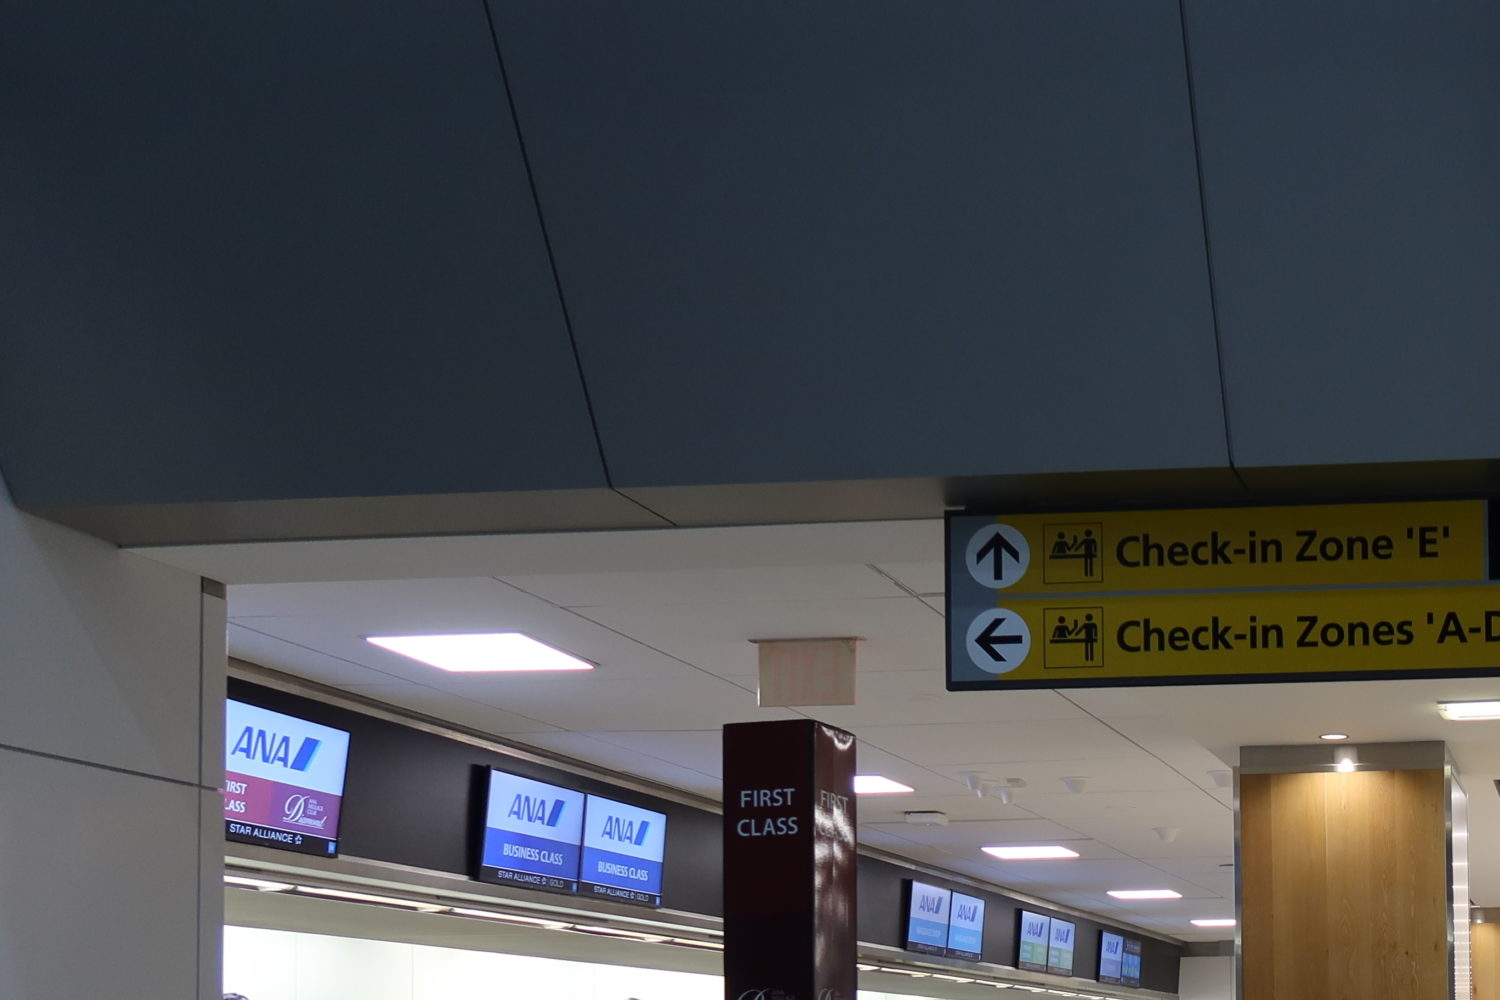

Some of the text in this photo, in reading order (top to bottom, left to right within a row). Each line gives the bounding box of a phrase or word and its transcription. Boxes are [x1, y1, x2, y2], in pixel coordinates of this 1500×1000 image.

[1115, 526, 1450, 568] Check-in Zone 'E'
[1116, 616, 1284, 652] Check-in
[1296, 615, 1414, 648] Zones
[231, 726, 290, 768] ANA
[225, 780, 247, 795] IRST
[740, 788, 796, 808] FIRST
[507, 793, 546, 825] ANA
[229, 823, 293, 844] STAR ALLIANCE
[601, 815, 633, 844] ANA
[737, 816, 799, 837] CLASS
[503, 843, 563, 866] BUSINESS CLASS
[498, 870, 564, 888] STAR ALLIANCE GOLD
[597, 861, 649, 881] BUSINESS CLASS
[593, 886, 607, 894] STAR
[606, 887, 631, 898] ALLIANCE
[919, 895, 936, 913] ANA
